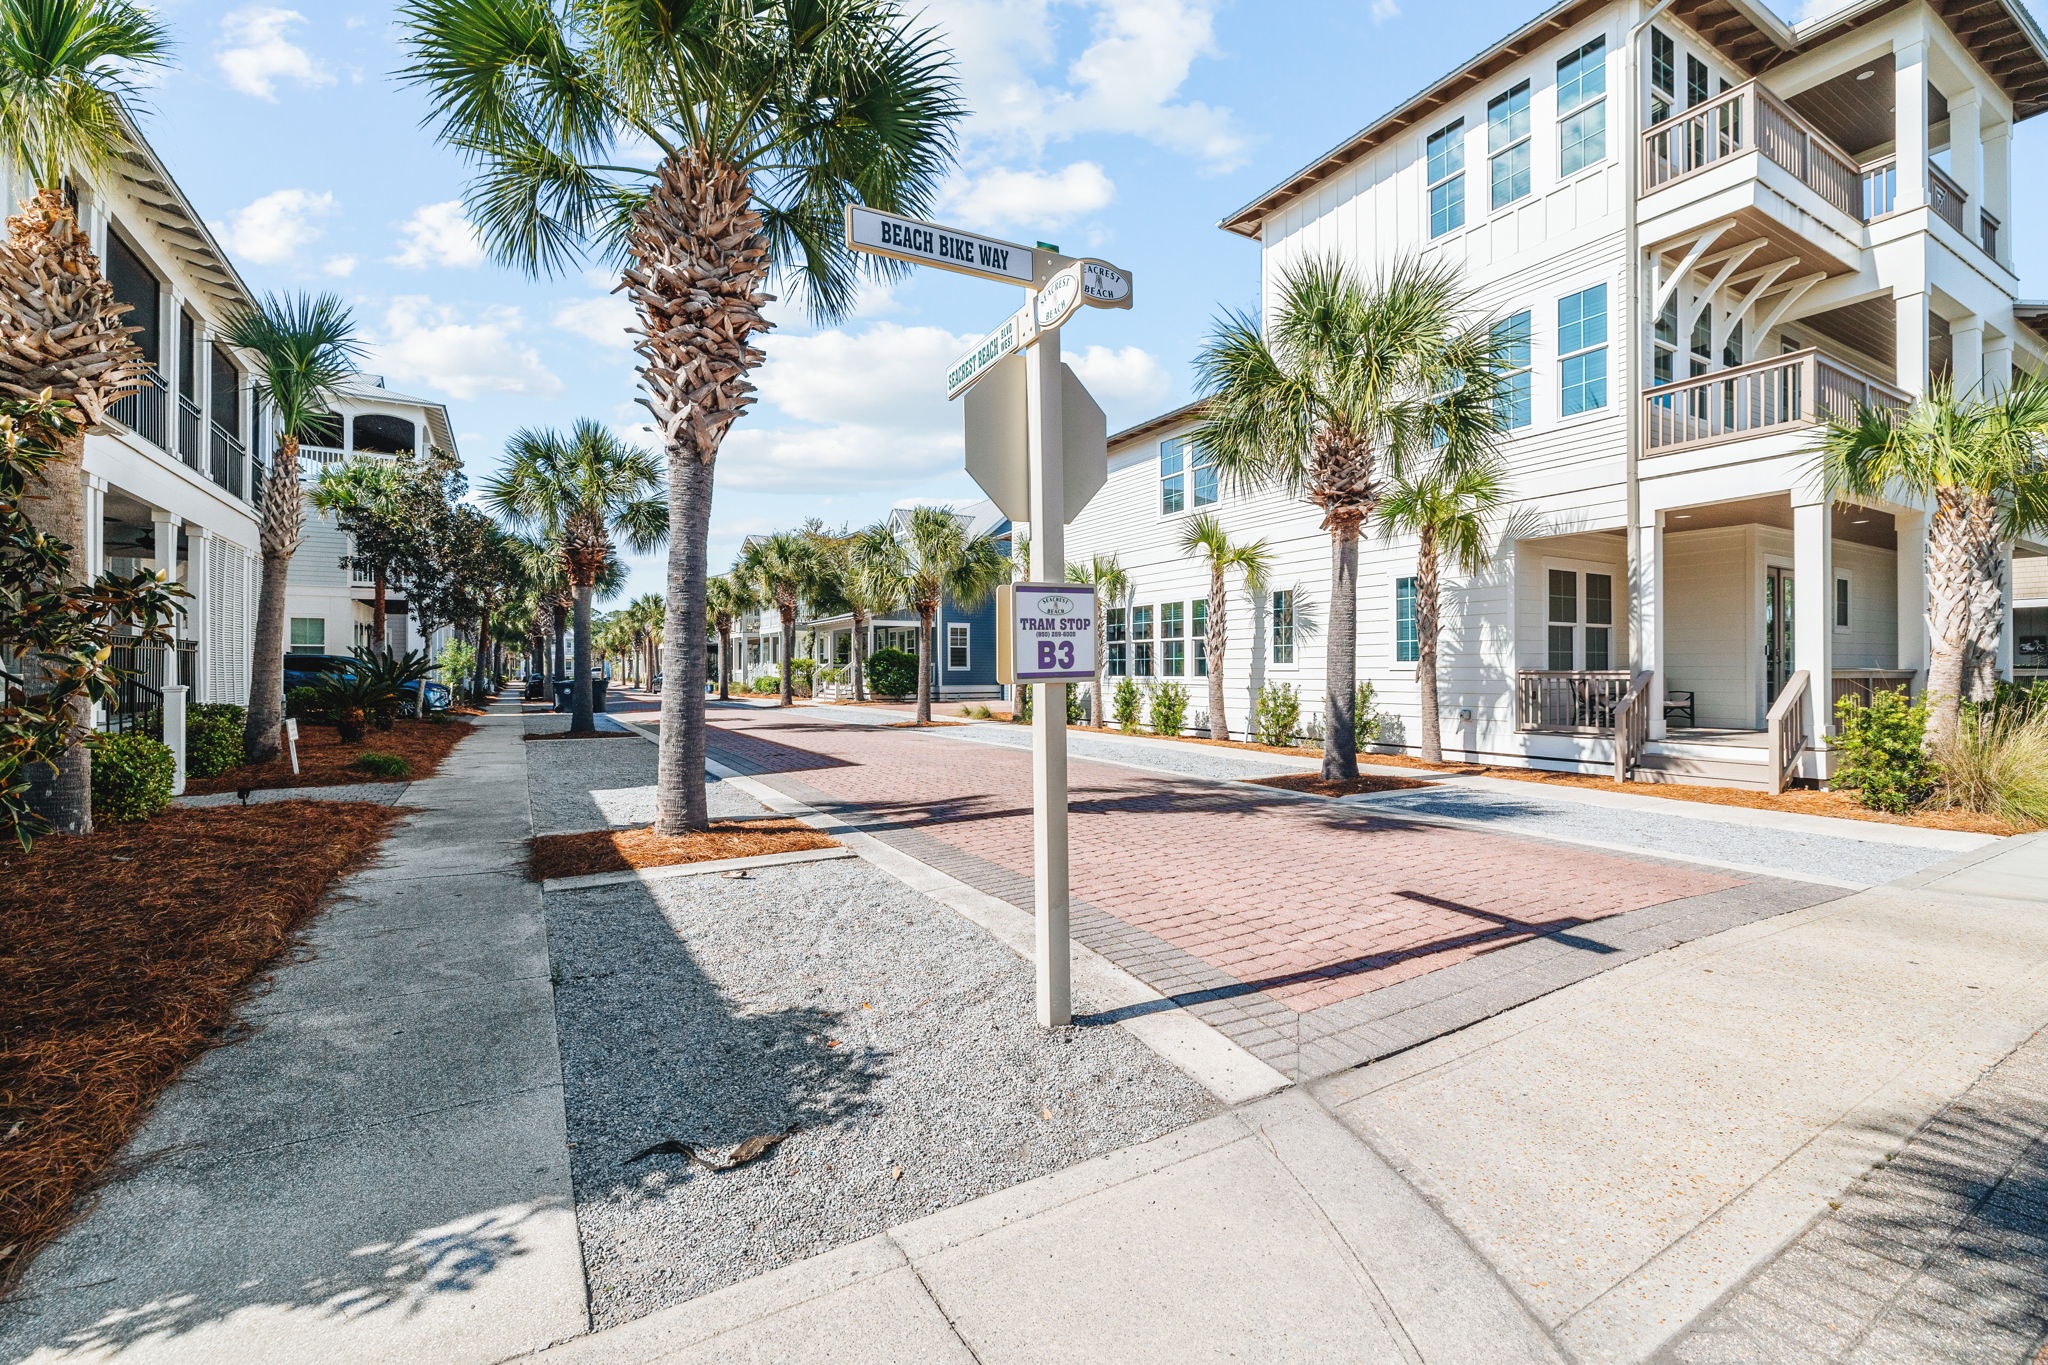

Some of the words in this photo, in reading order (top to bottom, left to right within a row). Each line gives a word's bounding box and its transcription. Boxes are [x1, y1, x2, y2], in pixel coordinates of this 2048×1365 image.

[881, 221, 934, 254] BEACH
[938, 234, 975, 263] BIKE
[978, 244, 1009, 271] WAY
[1084, 265, 1121, 283] EACREST
[1040, 277, 1070, 304] SEACREST
[1084, 284, 1114, 299] BEACH
[1045, 299, 1066, 321] BEACH
[1000, 322, 1013, 339] BLVD
[1000, 335, 1013, 352] WEST
[948, 354, 977, 391] SEACREST
[977, 336, 999, 368] BEACH
[1042, 597, 1069, 605] SEACREST
[1020, 618, 1056, 630] TRAM
[1059, 618, 1091, 631] STOP
[1037, 640, 1075, 670] B3
